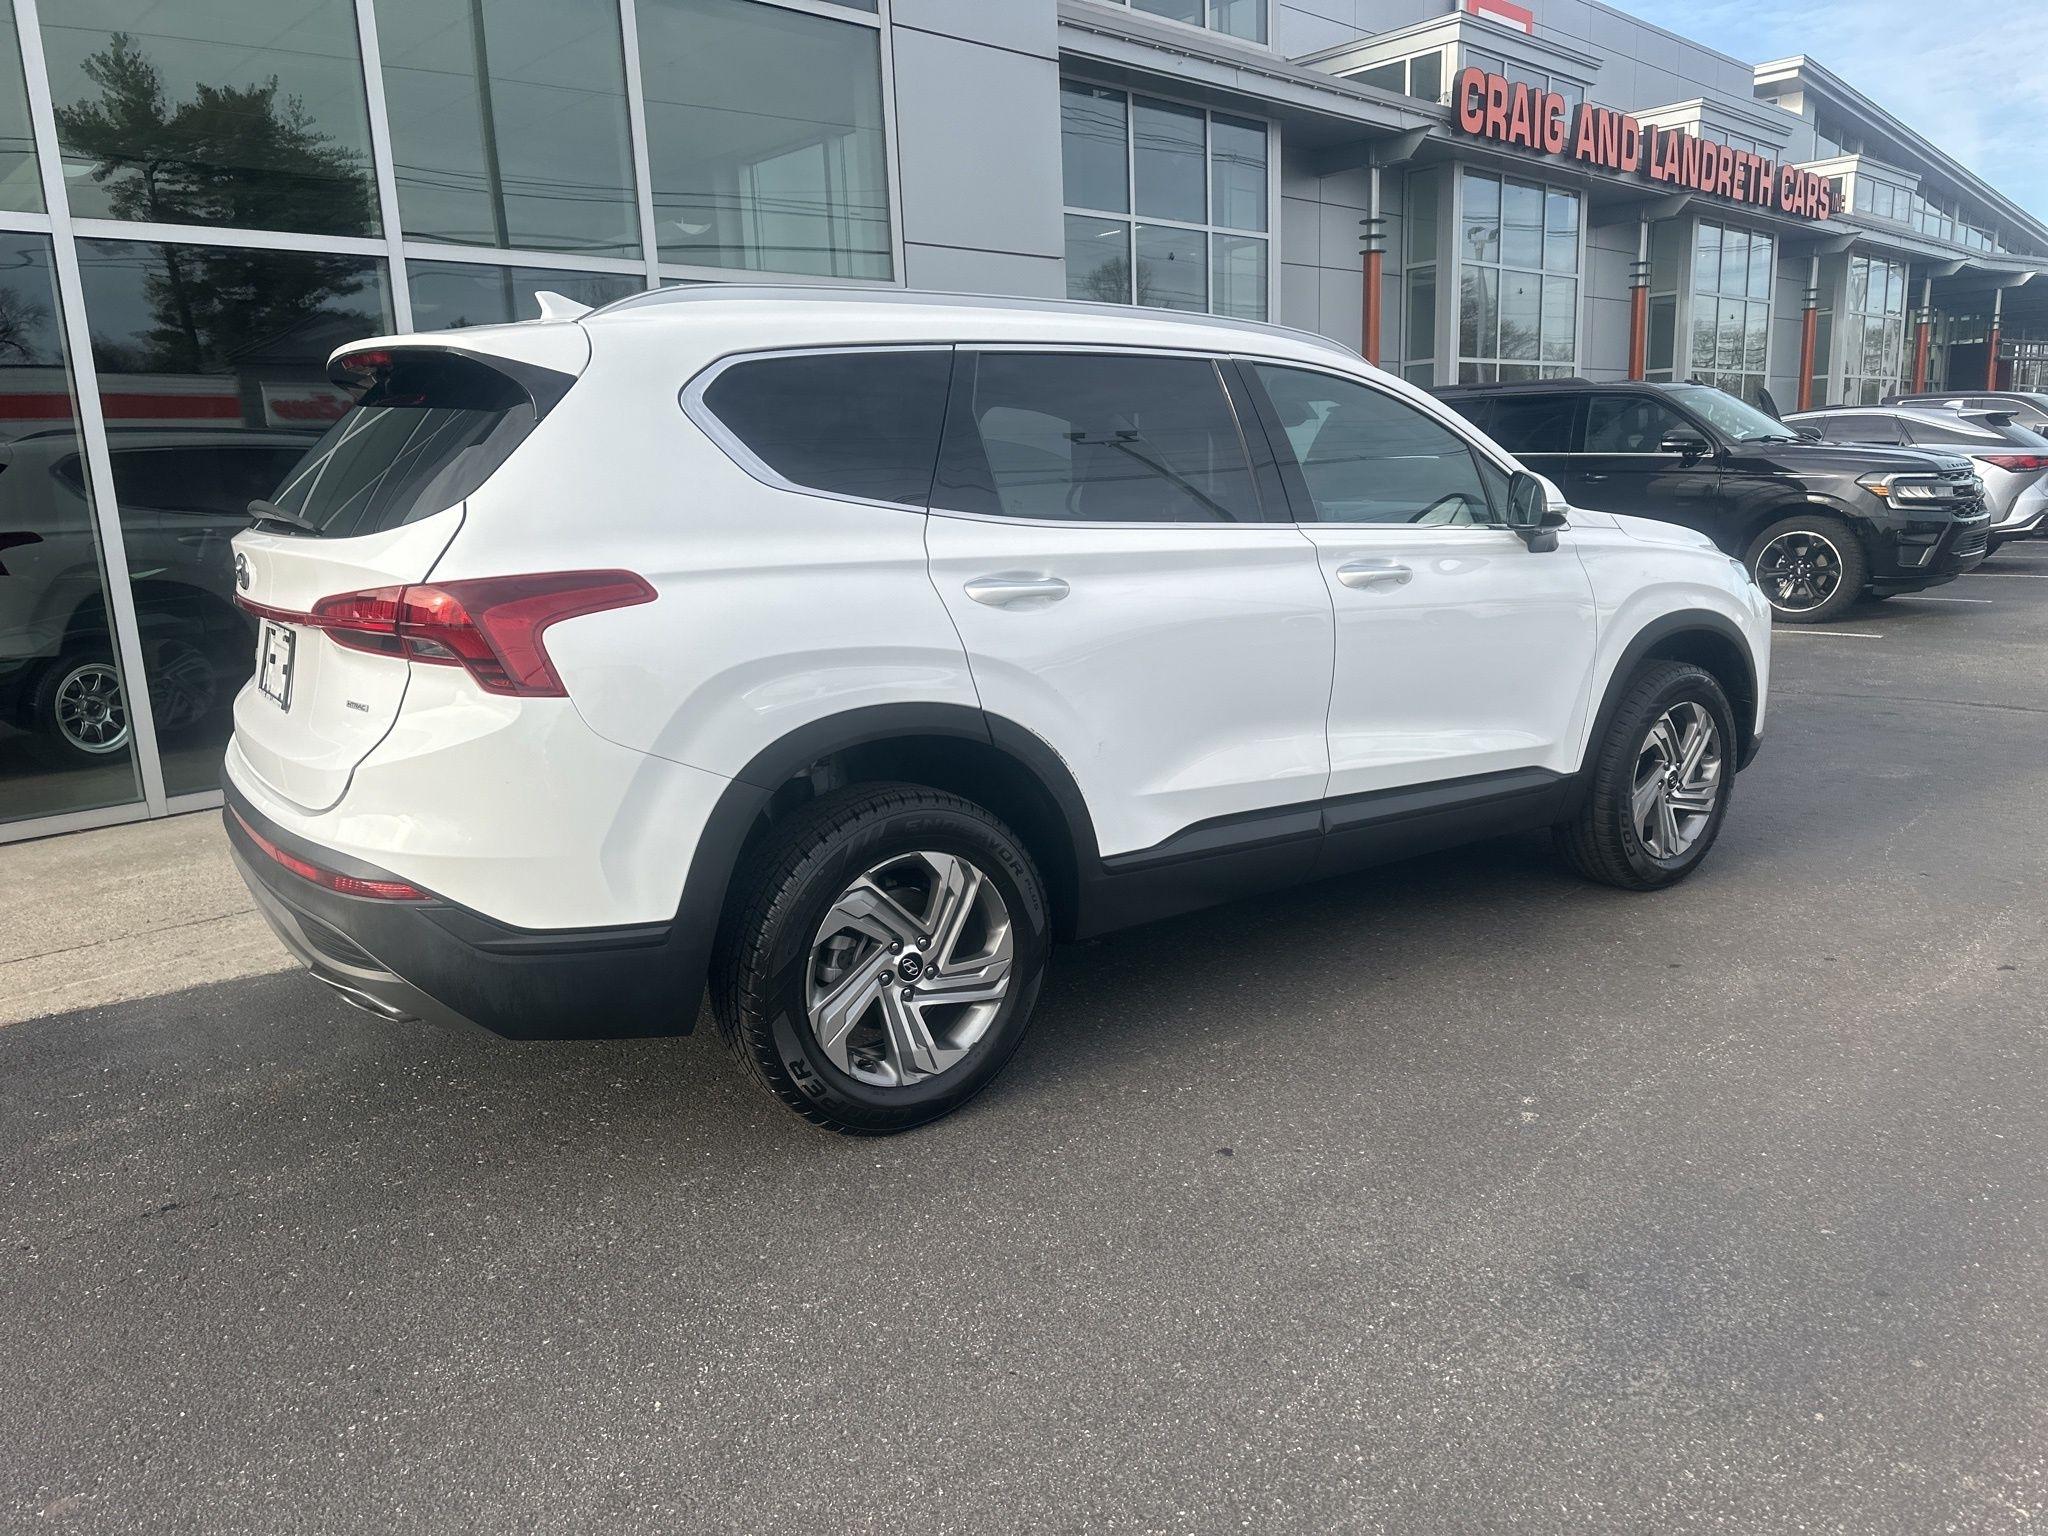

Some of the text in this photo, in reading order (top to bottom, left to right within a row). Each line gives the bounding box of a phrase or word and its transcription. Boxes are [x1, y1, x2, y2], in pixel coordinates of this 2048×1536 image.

[1457, 66, 1566, 155] CRAIG
[1575, 102, 1640, 172] AND
[1648, 123, 1775, 207] LANDRETH
[1779, 163, 1831, 221] CARS
